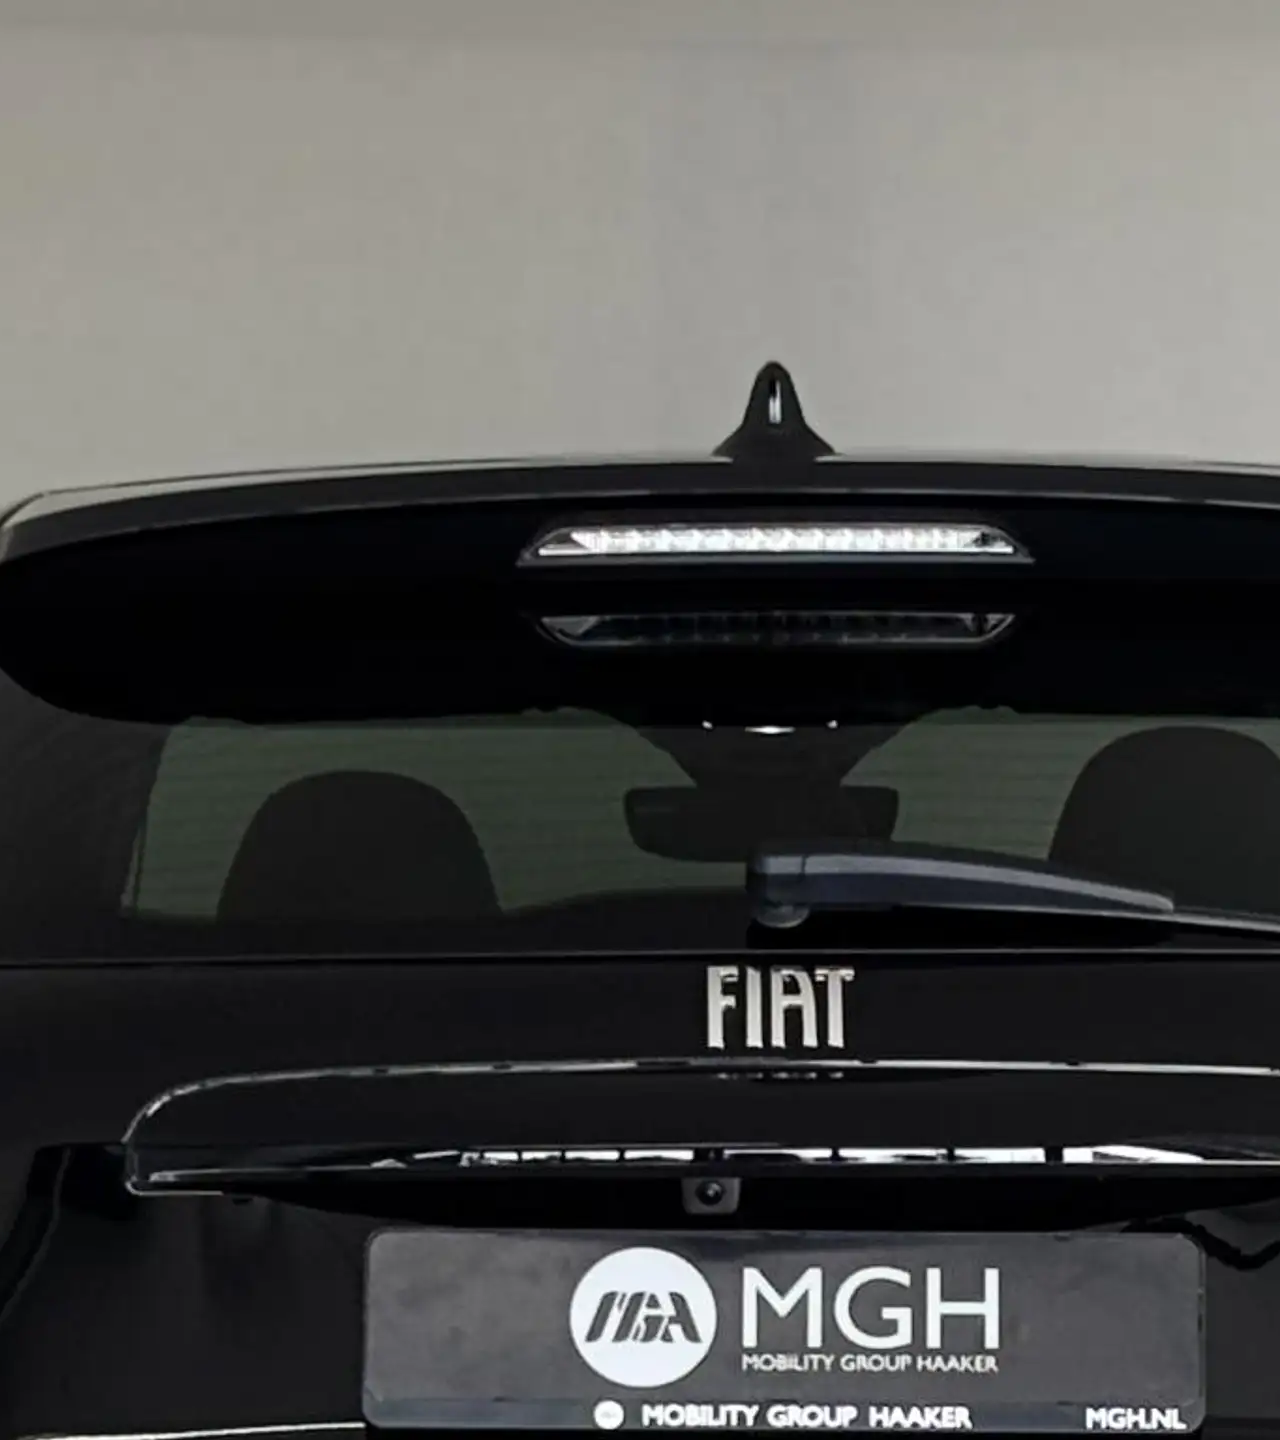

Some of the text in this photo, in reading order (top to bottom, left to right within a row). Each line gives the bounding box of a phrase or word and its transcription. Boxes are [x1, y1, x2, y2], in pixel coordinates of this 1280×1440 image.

[706, 965, 855, 1049] FIAT
[741, 1265, 1000, 1350] MGH
[741, 1353, 999, 1374] MOBILITY GROUP HAAKER
[641, 1403, 973, 1430] MOBILITY GROUP HAAKER
[1084, 1407, 1188, 1430] MGH.NL
